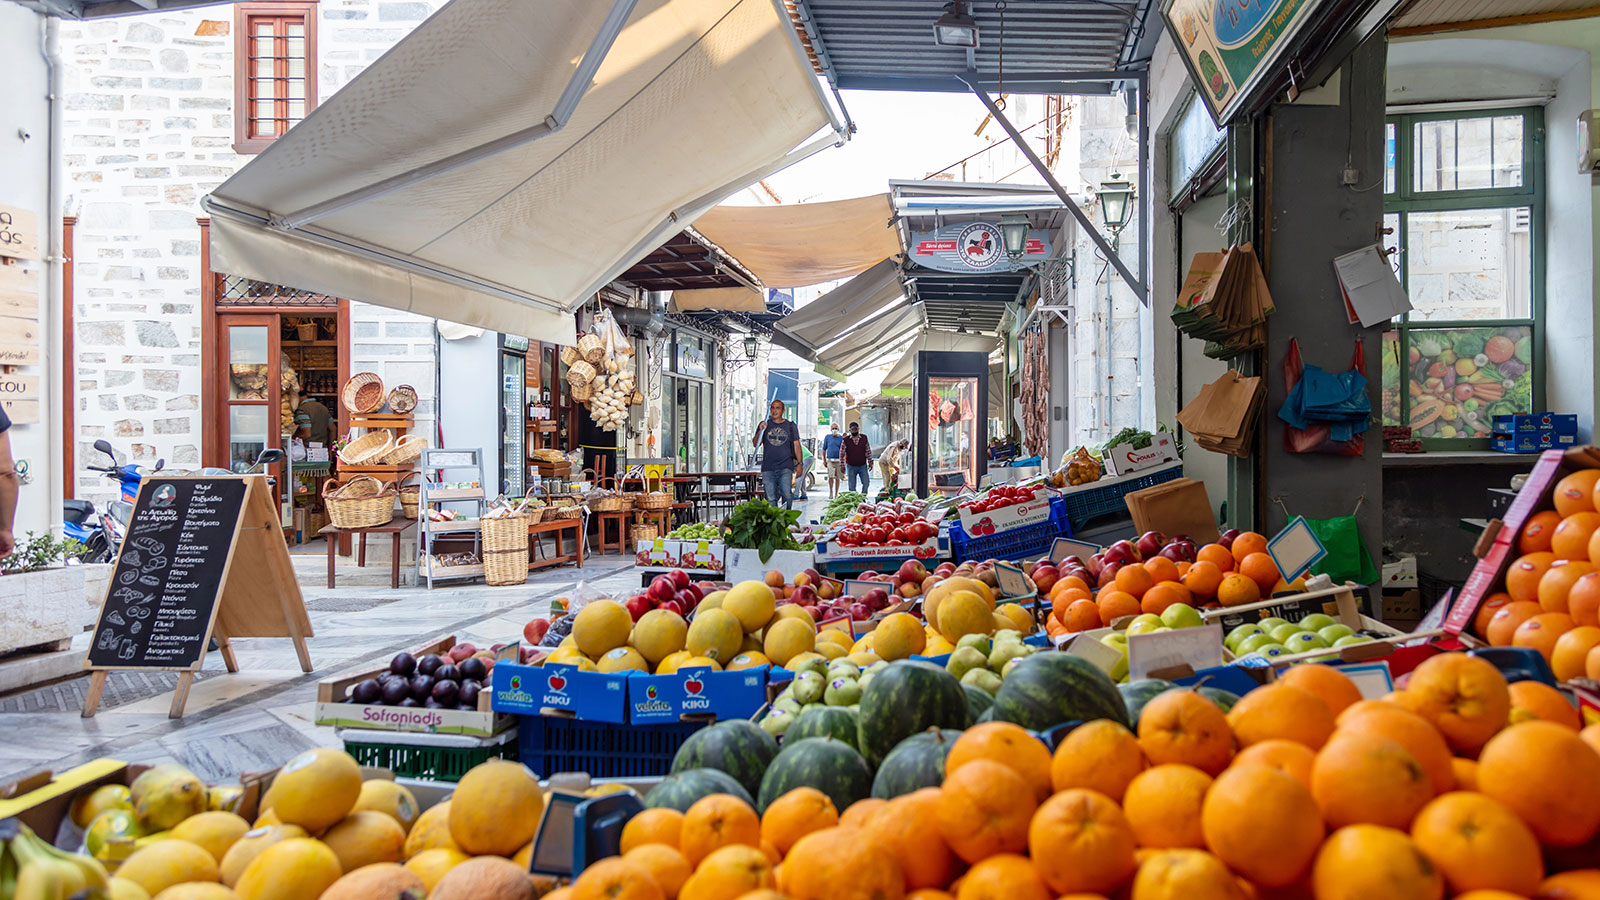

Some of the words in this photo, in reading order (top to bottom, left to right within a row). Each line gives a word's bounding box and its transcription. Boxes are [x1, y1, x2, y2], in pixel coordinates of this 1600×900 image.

[543, 695, 571, 706] KIKU
[682, 699, 710, 710] KIKU
[363, 707, 443, 726] Sofroniadis
